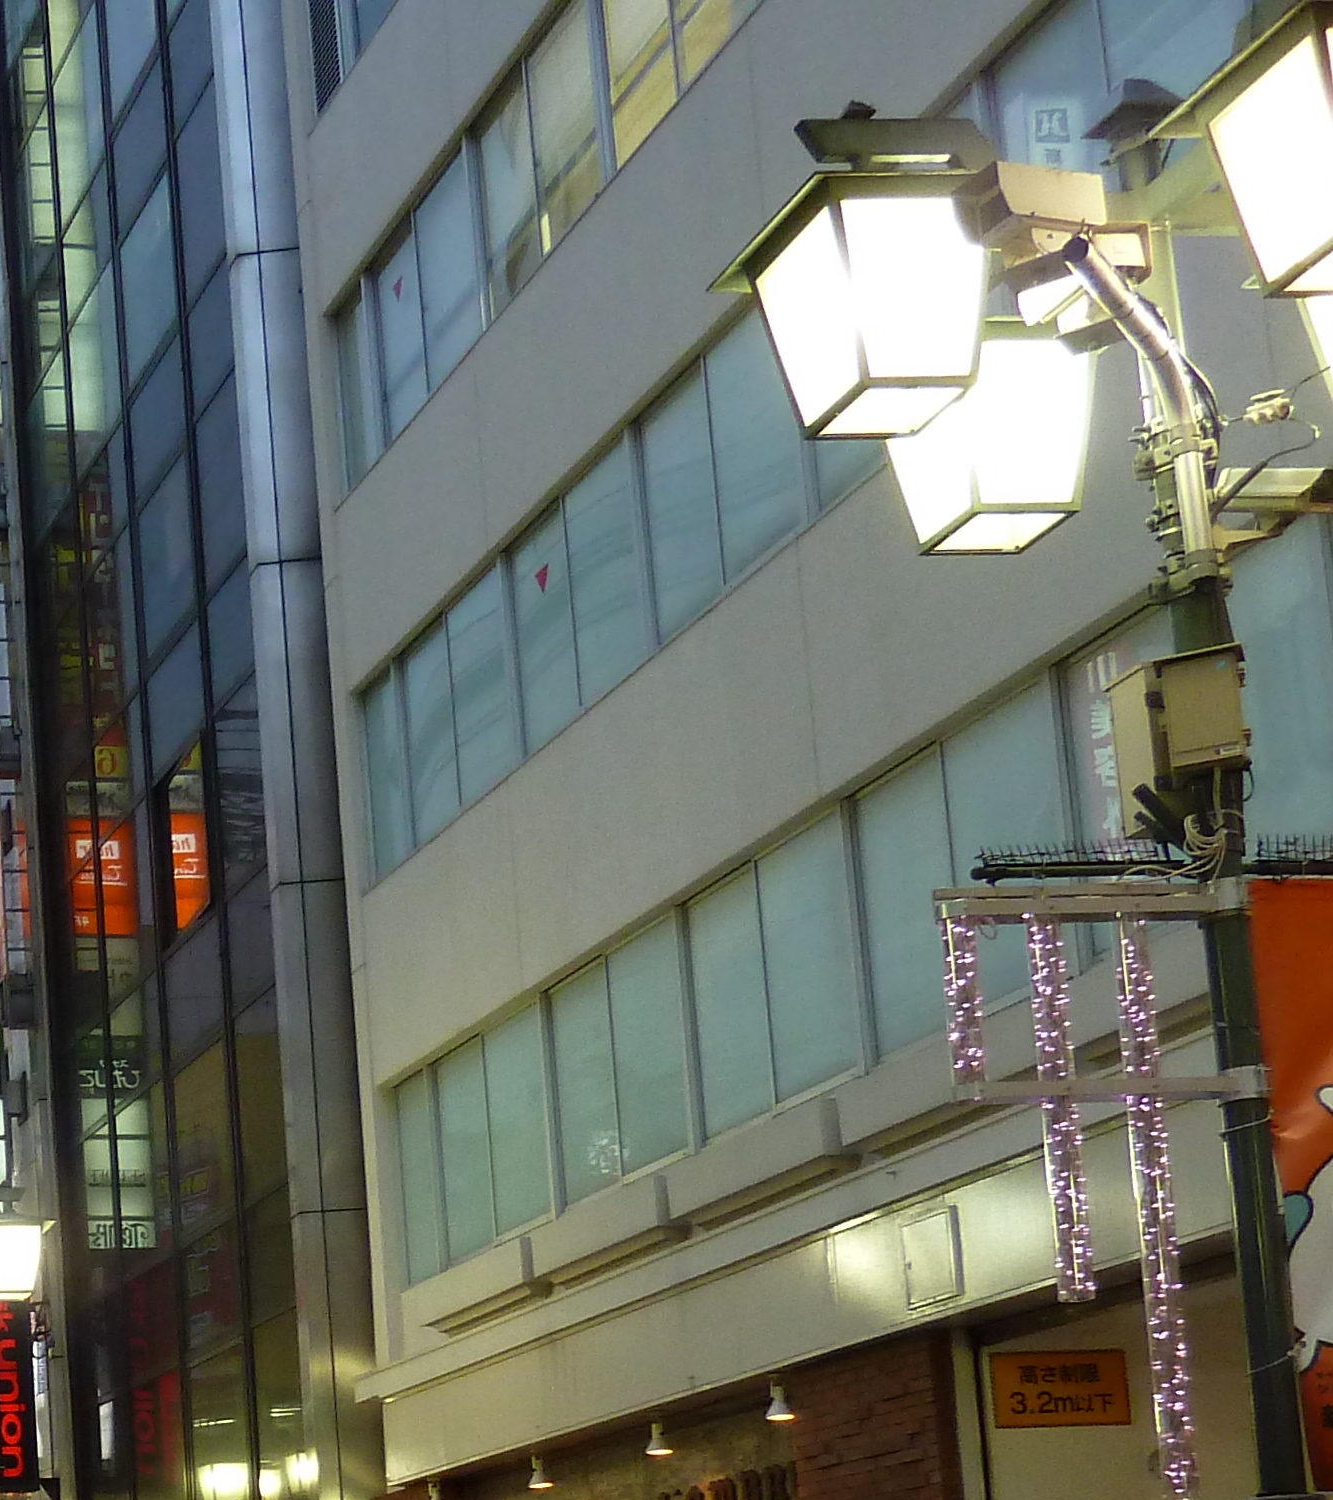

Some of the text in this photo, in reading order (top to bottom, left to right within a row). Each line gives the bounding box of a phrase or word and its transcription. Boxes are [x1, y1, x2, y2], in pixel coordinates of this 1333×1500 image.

[1017, 1363, 1101, 1387] 高さ制限
[1009, 1389, 1114, 1418] 3.2m以下
